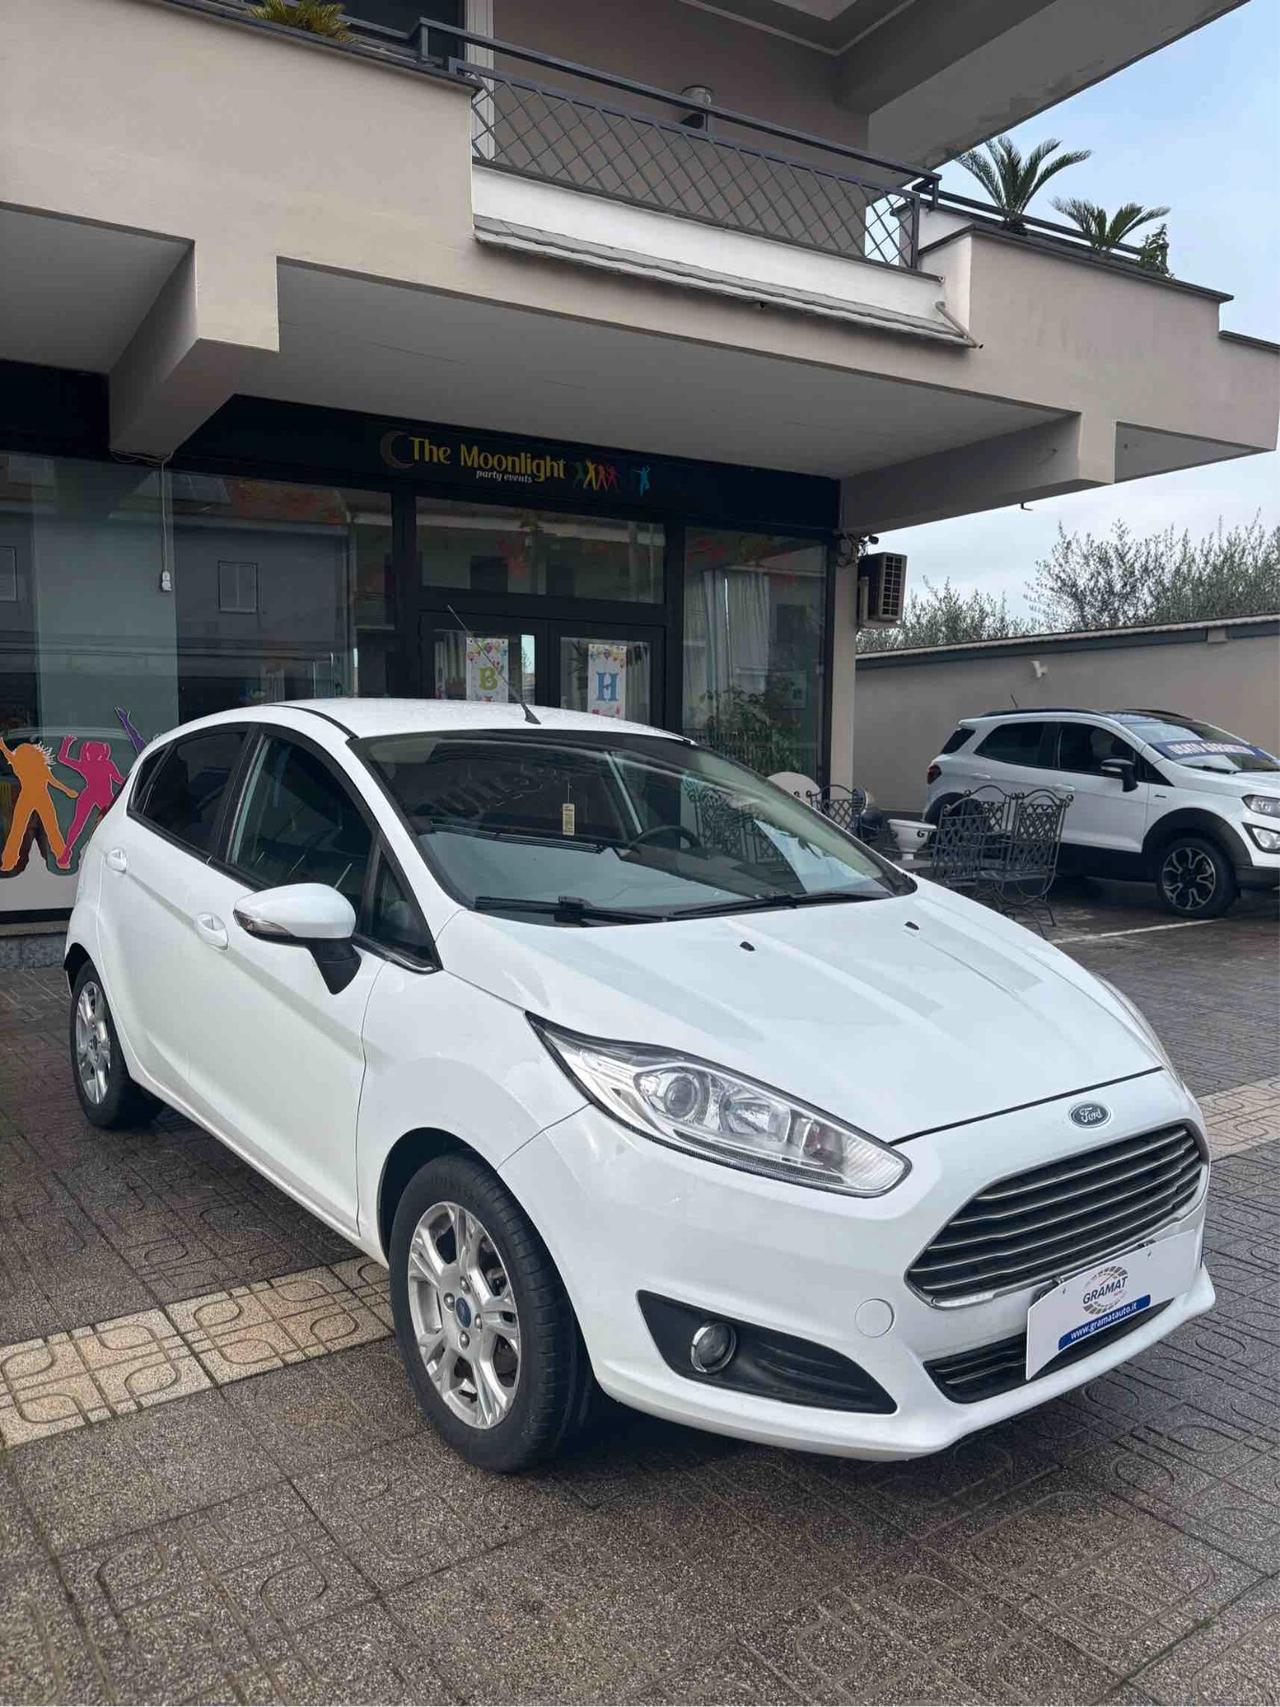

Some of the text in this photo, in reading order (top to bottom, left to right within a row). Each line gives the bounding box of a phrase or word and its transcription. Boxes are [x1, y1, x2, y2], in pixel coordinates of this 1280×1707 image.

[409, 436, 567, 482] The Moonlight
[476, 469, 534, 484] party events
[479, 667, 498, 692] B
[596, 672, 619, 702] H
[1079, 1107, 1103, 1123] Ford
[1083, 1276, 1129, 1304] GRAMAT
[1070, 1302, 1138, 1341] www.gramatauto.it
